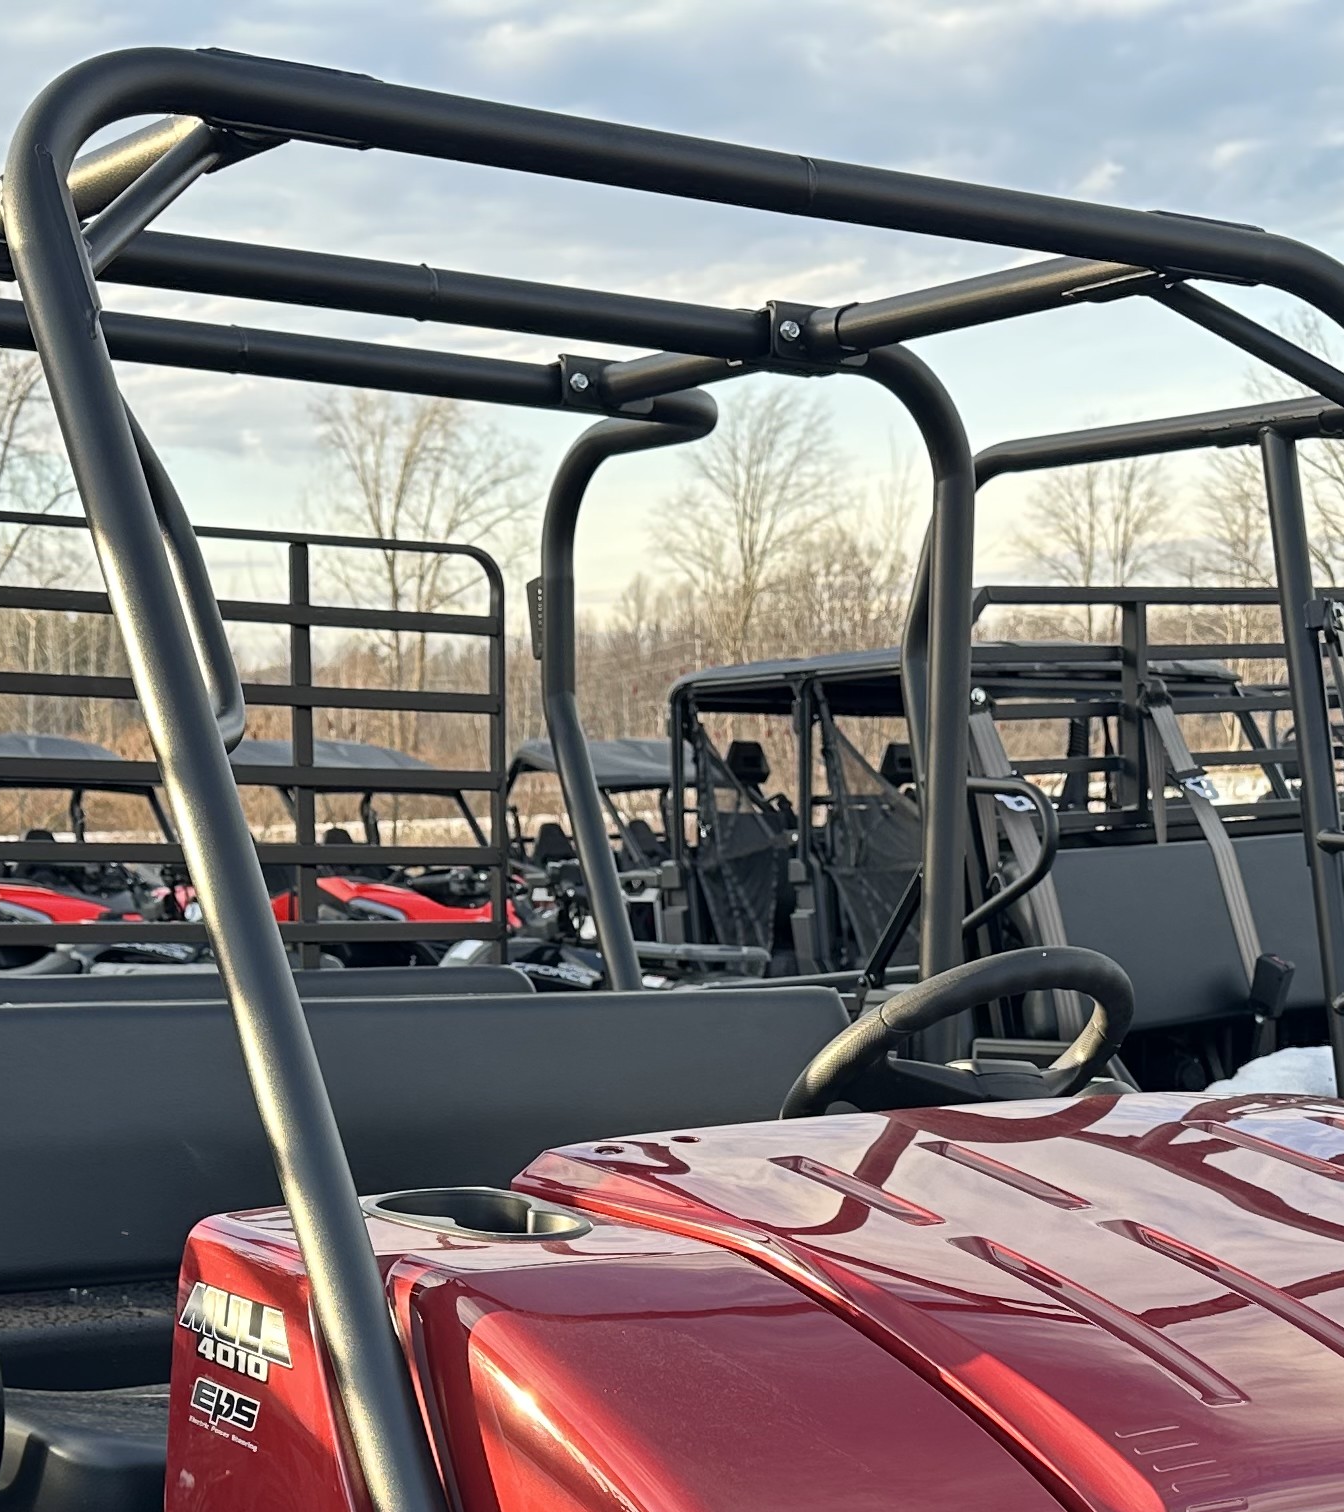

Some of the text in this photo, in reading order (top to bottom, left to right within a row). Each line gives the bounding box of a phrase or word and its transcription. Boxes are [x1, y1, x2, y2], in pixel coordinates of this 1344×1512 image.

[179, 1281, 294, 1369] MULE
[197, 1337, 269, 1383] 4010
[190, 1376, 261, 1432] EPS
